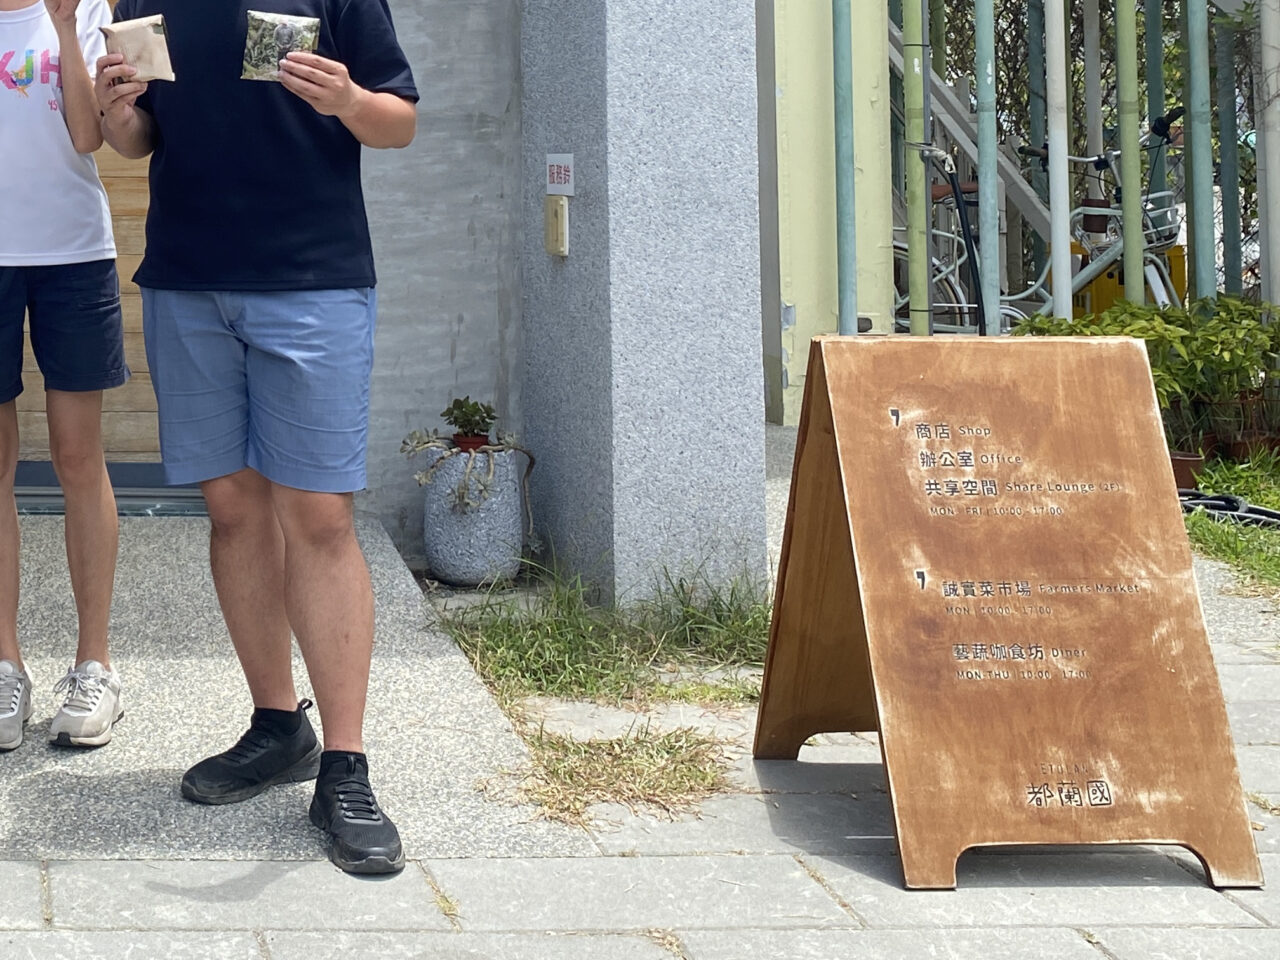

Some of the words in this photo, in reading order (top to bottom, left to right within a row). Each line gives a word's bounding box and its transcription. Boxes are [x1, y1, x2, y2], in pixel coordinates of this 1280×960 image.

[915, 423, 951, 439] 商店
[958, 425, 991, 437] Shop
[919, 451, 974, 467] 辦公室
[980, 454, 1021, 464] Office
[925, 479, 998, 496] 共享空間
[1005, 481, 1043, 492] Share
[1048, 481, 1095, 494] Lounge
[930, 506, 955, 516] MON
[966, 506, 982, 516] FRI
[942, 580, 1032, 597] 誠實菜市場
[1039, 583, 1091, 594] Farmers
[1095, 582, 1140, 593] Market
[945, 606, 970, 615] MON
[1051, 647, 1088, 658] Diner
[1025, 780, 1112, 807] 都蘭國
